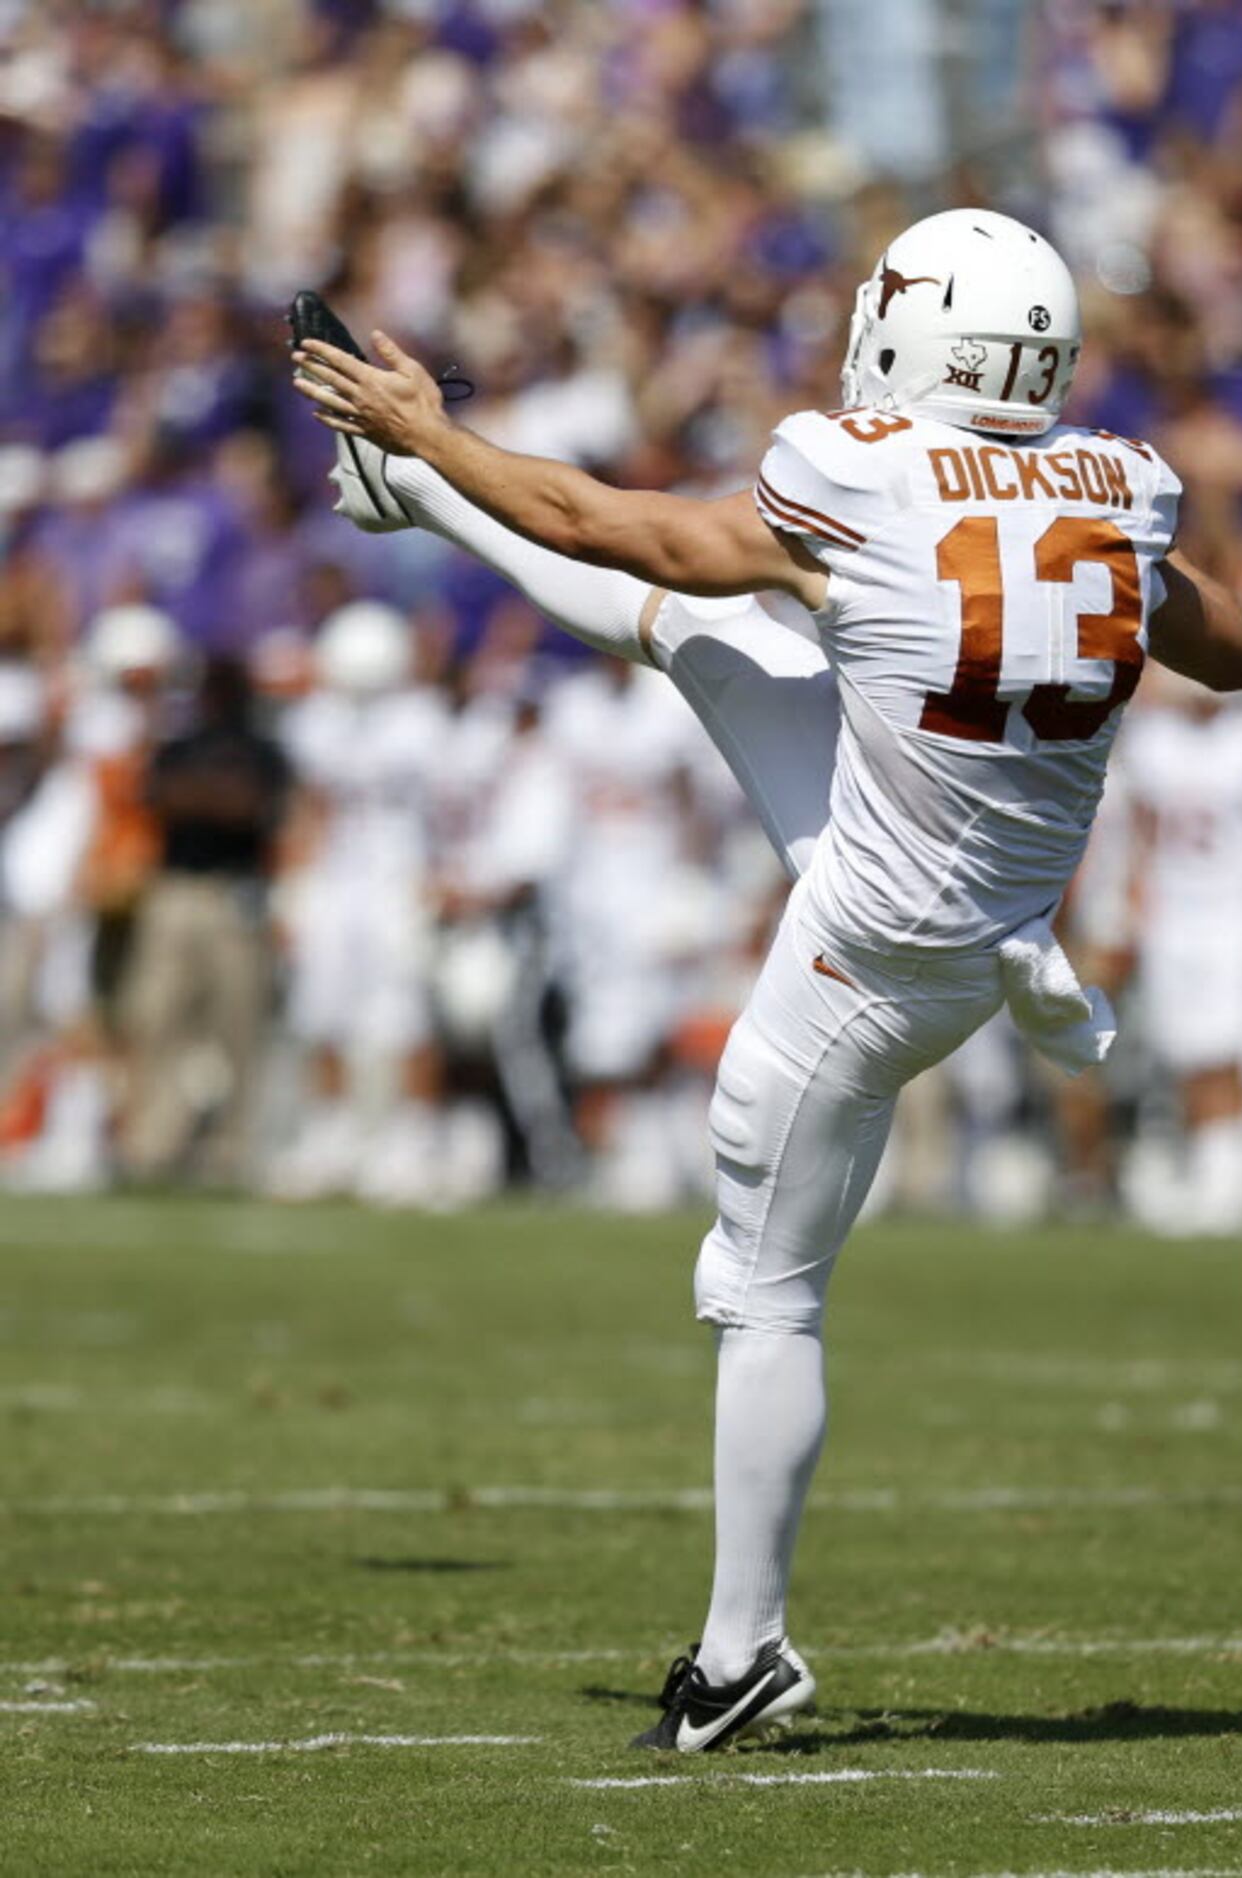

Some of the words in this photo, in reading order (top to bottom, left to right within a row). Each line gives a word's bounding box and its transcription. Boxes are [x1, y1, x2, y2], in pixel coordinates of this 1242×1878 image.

[942, 363, 984, 392] XII
[999, 341, 1059, 405] 13
[927, 446, 1133, 510] DICKSON
[917, 515, 1145, 743] 13
